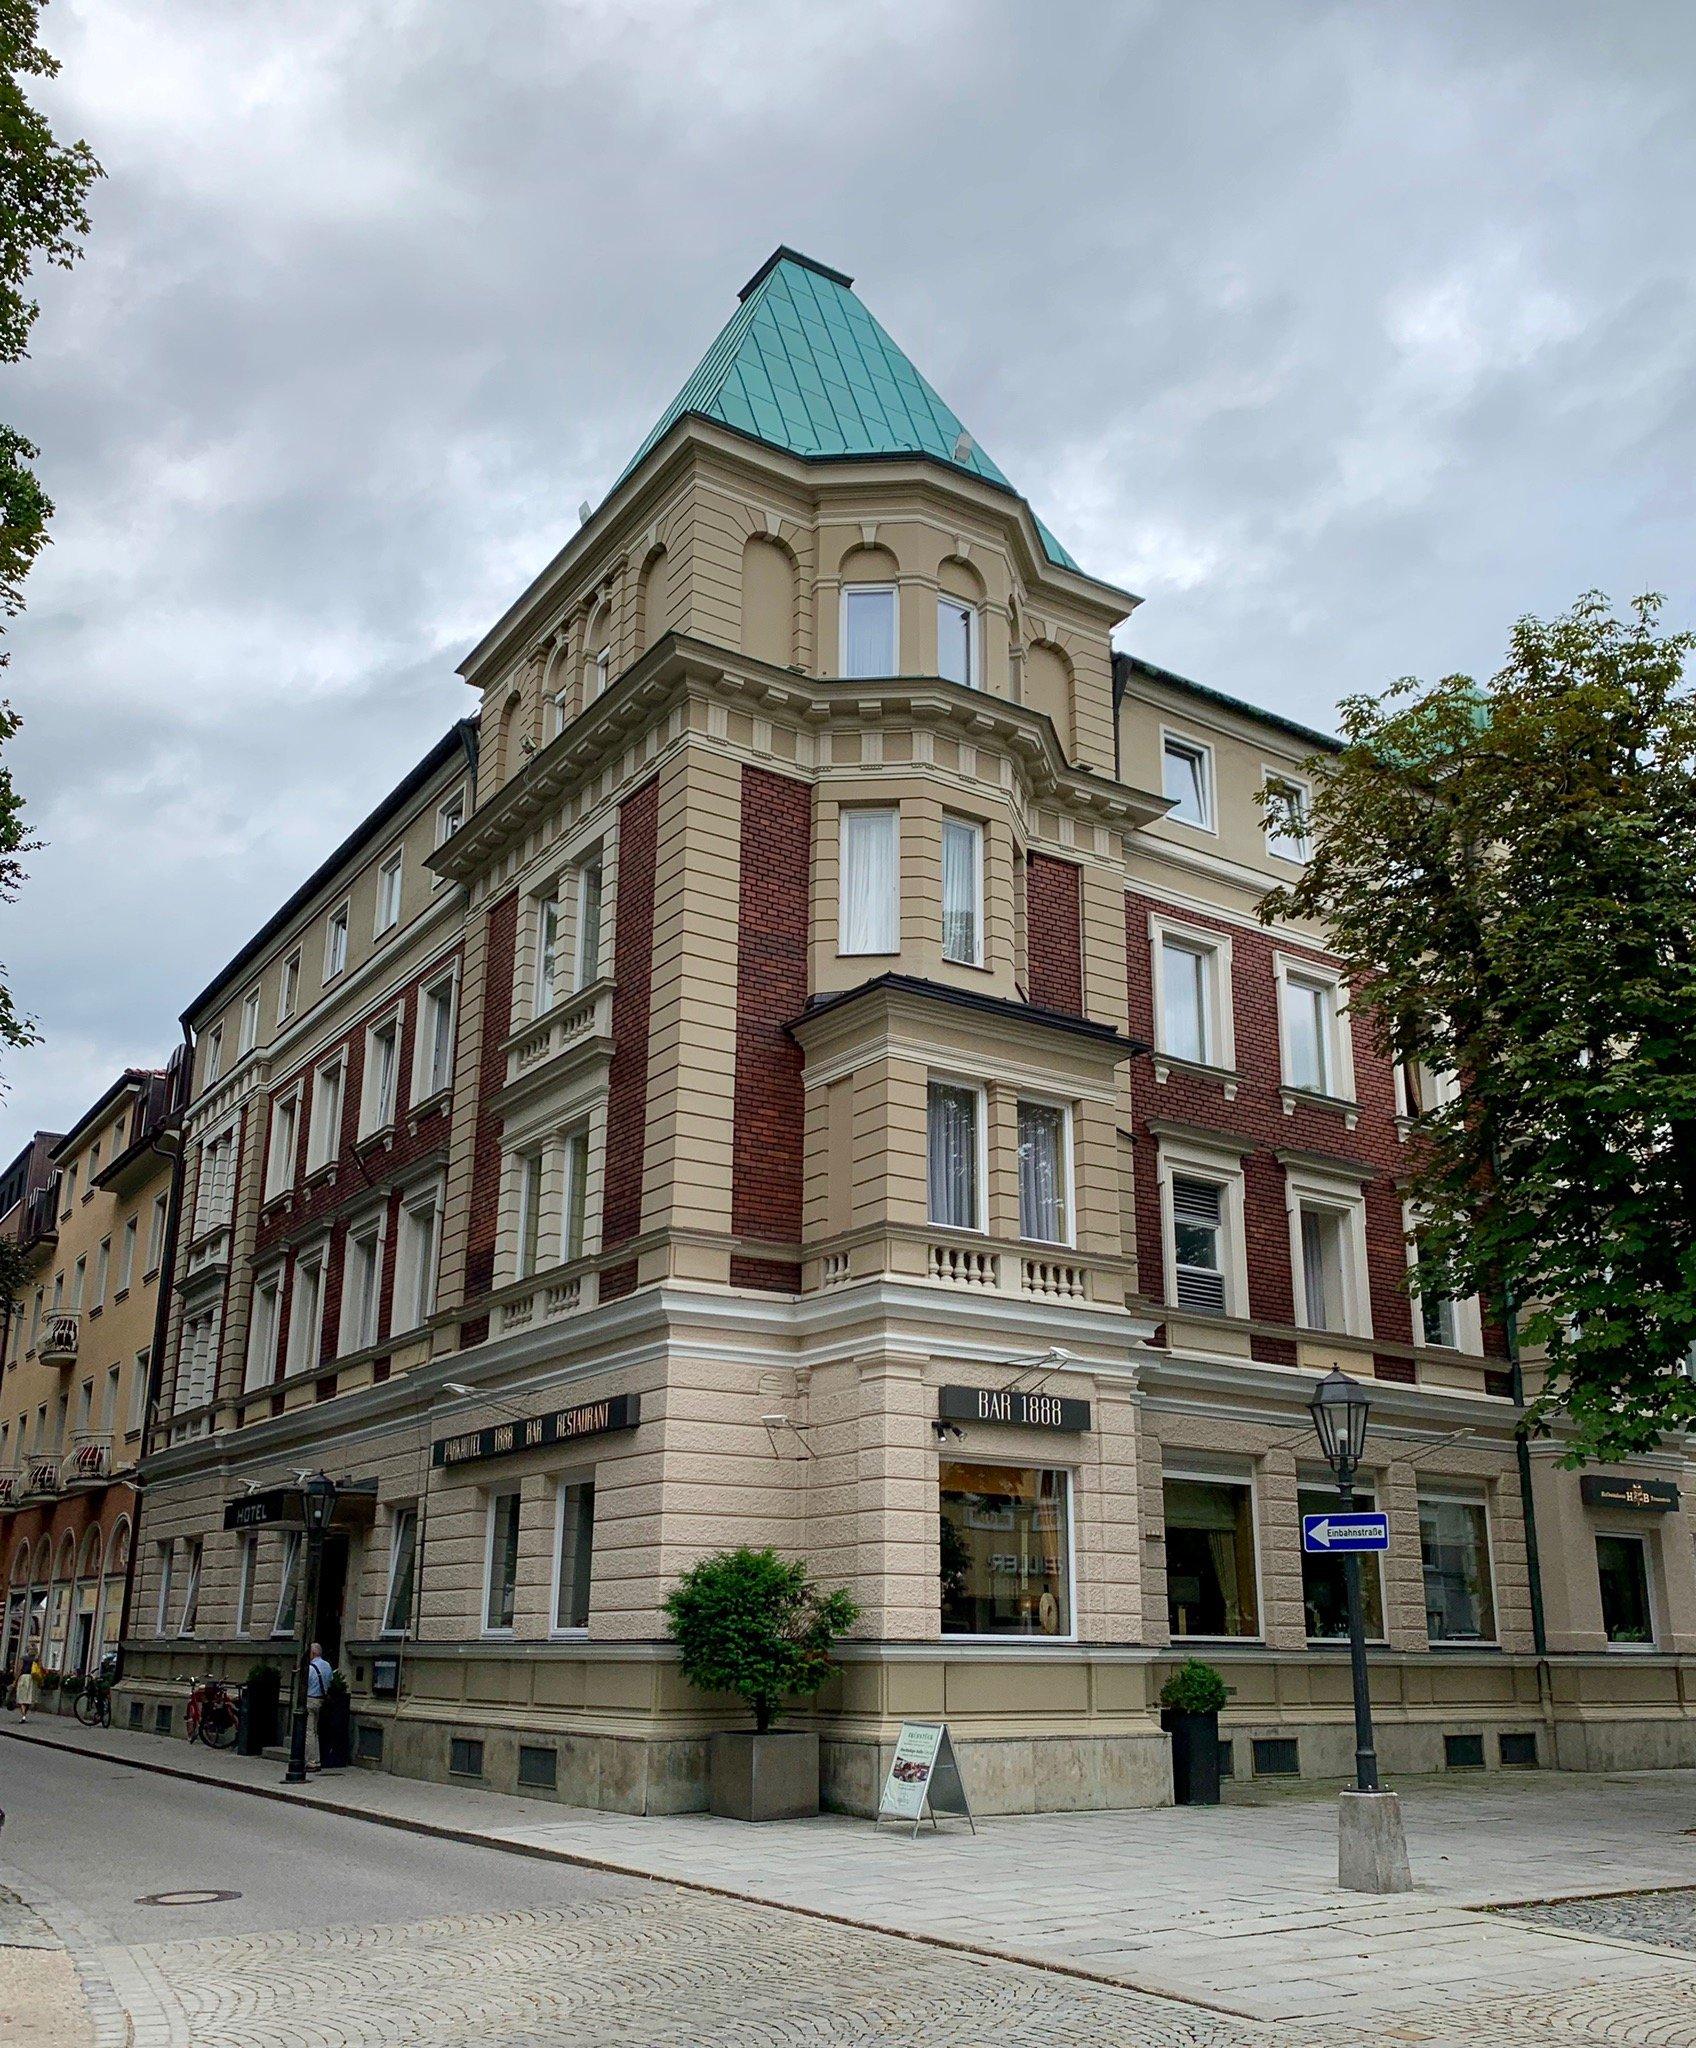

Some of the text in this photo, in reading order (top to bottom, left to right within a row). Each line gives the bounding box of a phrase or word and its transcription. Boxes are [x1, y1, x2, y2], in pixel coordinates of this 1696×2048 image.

[979, 1391, 1061, 1425] BAR 1888
[444, 1402, 610, 1462] PARKHOTEL 1888 BAR RESTAURANT
[237, 1504, 267, 1523] HOTEL
[1327, 1527, 1383, 1538] Einbahnstraße
